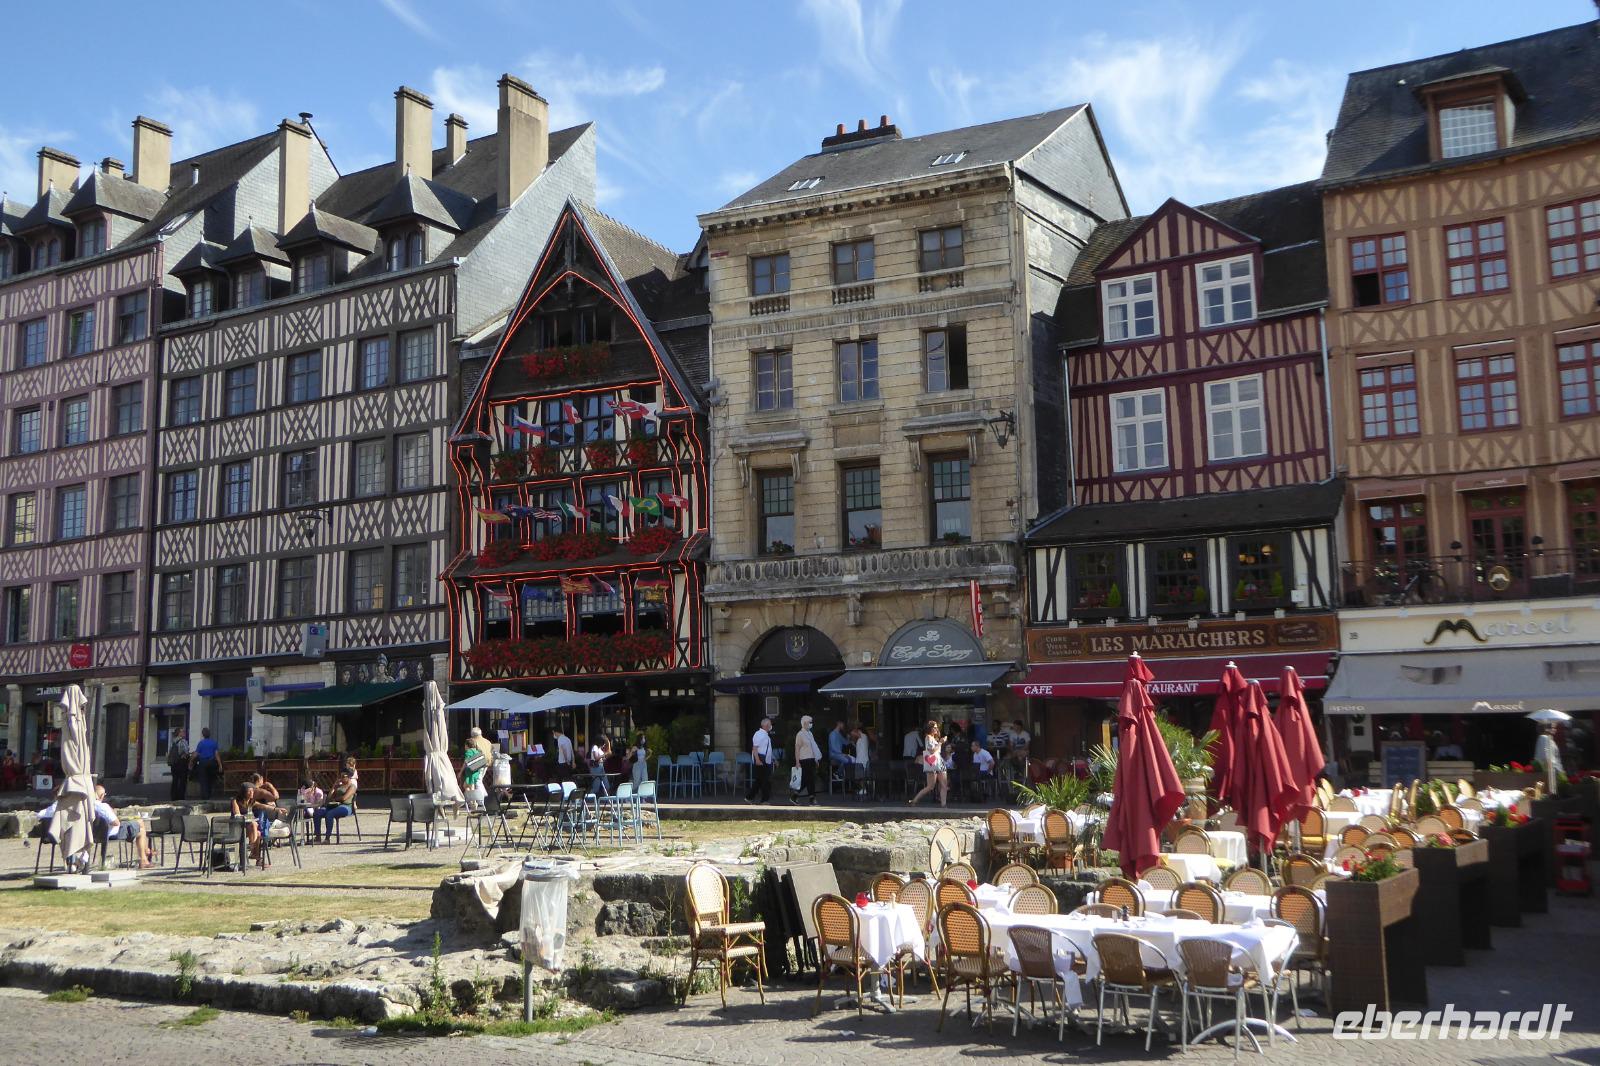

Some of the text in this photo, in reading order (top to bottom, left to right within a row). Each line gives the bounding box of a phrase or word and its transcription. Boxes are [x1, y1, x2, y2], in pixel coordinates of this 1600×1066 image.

[1090, 636, 1124, 652] LES
[1132, 629, 1265, 650] MARAICHERS
[1146, 682, 1199, 695] TAURANT
